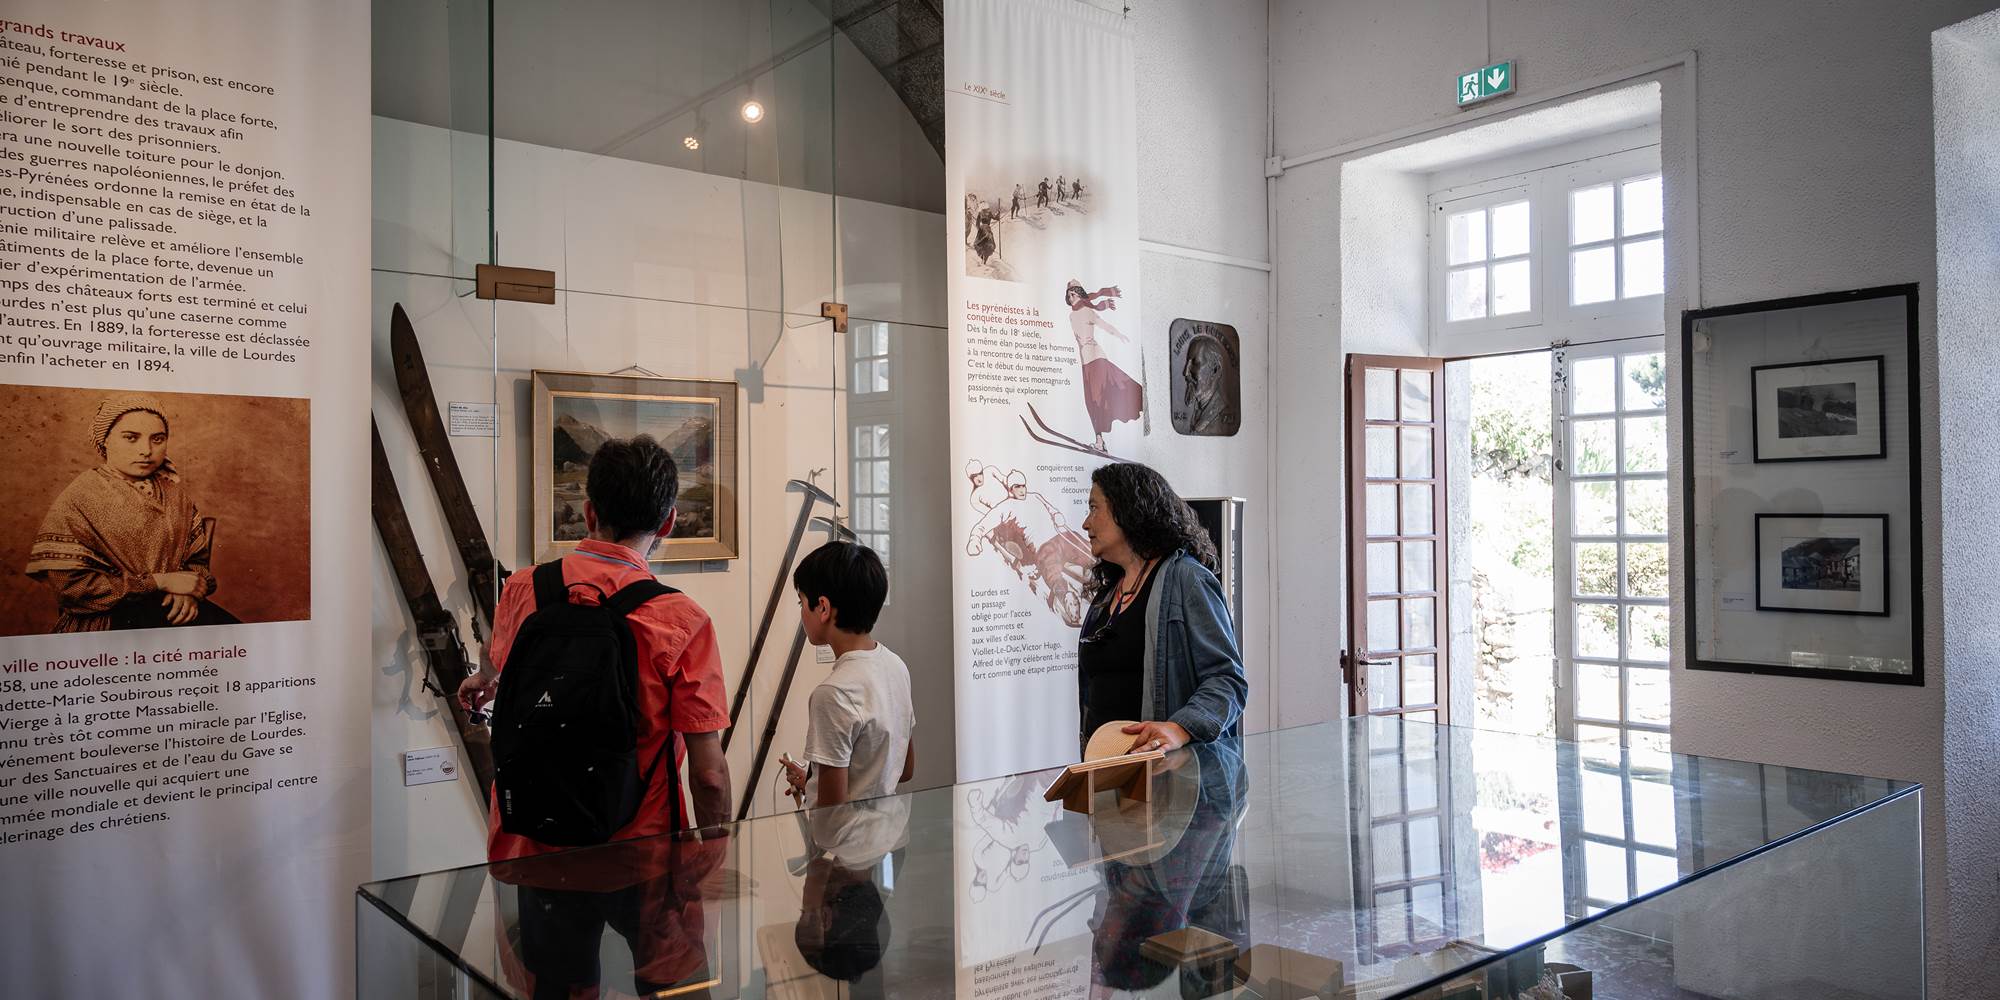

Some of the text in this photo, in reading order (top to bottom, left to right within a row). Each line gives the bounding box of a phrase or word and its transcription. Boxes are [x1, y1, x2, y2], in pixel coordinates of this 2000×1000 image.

[60, 31, 125, 52] travaux
[26, 63, 88, 81] pendant
[94, 71, 106, 84] le
[140, 80, 182, 96] siècle.
[49, 46, 128, 72] forteresse
[132, 64, 147, 73] et
[152, 67, 199, 84] prison,
[203, 76, 223, 87] est
[228, 81, 274, 95] encore
[62, 88, 158, 110] commandant
[164, 101, 180, 113] de
[186, 104, 197, 116] la
[202, 108, 236, 122] place
[240, 113, 277, 130] forte,
[30, 155, 87, 170] guerres
[94, 164, 208, 187] napoléoniennes,
[213, 176, 224, 188] le
[229, 180, 269, 194] préfet
[274, 185, 294, 198] des
[94, 181, 157, 197] ordonne
[163, 186, 174, 199] la
[180, 192, 224, 206] remise
[230, 199, 246, 208] en
[251, 198, 276, 212] état
[281, 203, 296, 214] de
[301, 205, 310, 216] la
[62, 210, 103, 226] d'une
[109, 218, 176, 234] palissade.
[34, 227, 95, 242] militaire
[102, 234, 145, 248] relève
[151, 241, 165, 250] et
[170, 242, 230, 256] améliore
[236, 247, 303, 264] l'ensemble
[27, 261, 164, 285] d'expérimentation
[170, 274, 186, 286] de
[192, 276, 246, 292] l'armée.
[967, 300, 979, 310] Les
[982, 304, 1024, 316] pyrénéistes
[1032, 308, 1039, 316] la
[967, 314, 1054, 328] conquête des sommets
[0, 313, 310, 347] 'autres. En 1889, la forteresse est déclassée
[967, 324, 980, 332] Dès
[42, 353, 107, 368] l'acheter
[112, 361, 129, 370] en
[138, 359, 174, 372] 1894.
[968, 359, 1062, 373] C'est le début du mouvement
[968, 384, 1048, 396] passionnés qui explorent
[971, 588, 998, 598] Lourdes
[982, 601, 1006, 611] passage
[971, 610, 1031, 622] obligé pour l'accès
[986, 624, 1015, 632] sommets
[3, 659, 38, 674] ville
[46, 653, 118, 671] nouvelle
[134, 651, 147, 664] la
[153, 652, 182, 663] cité
[189, 645, 246, 660] mariale
[0, 666, 218, 693] 58, une adolescente nommée
[100, 689, 174, 703] Soubirous
[178, 683, 219, 697] reçoit
[227, 681, 240, 692] 18
[245, 677, 316, 693] apparitions
[55, 713, 62, 725] à
[68, 712, 80, 724] la
[84, 710, 130, 726] grotte
[136, 700, 218, 718] Massabielle.
[80, 743, 159, 759] bouleverse
[165, 736, 224, 750] l'histoire
[230, 731, 246, 743] de
[252, 726, 306, 741] Lourdes.
[0, 768, 249, 806] une ville nouvelle qui acquiert une
[52, 799, 118, 818] mondiale
[124, 798, 138, 808] et
[144, 790, 195, 805] devient
[200, 787, 211, 797] le
[216, 778, 272, 799] principal
[277, 776, 317, 788] centre
[70, 821, 94, 833] des
[100, 812, 170, 829] chrétiens.
